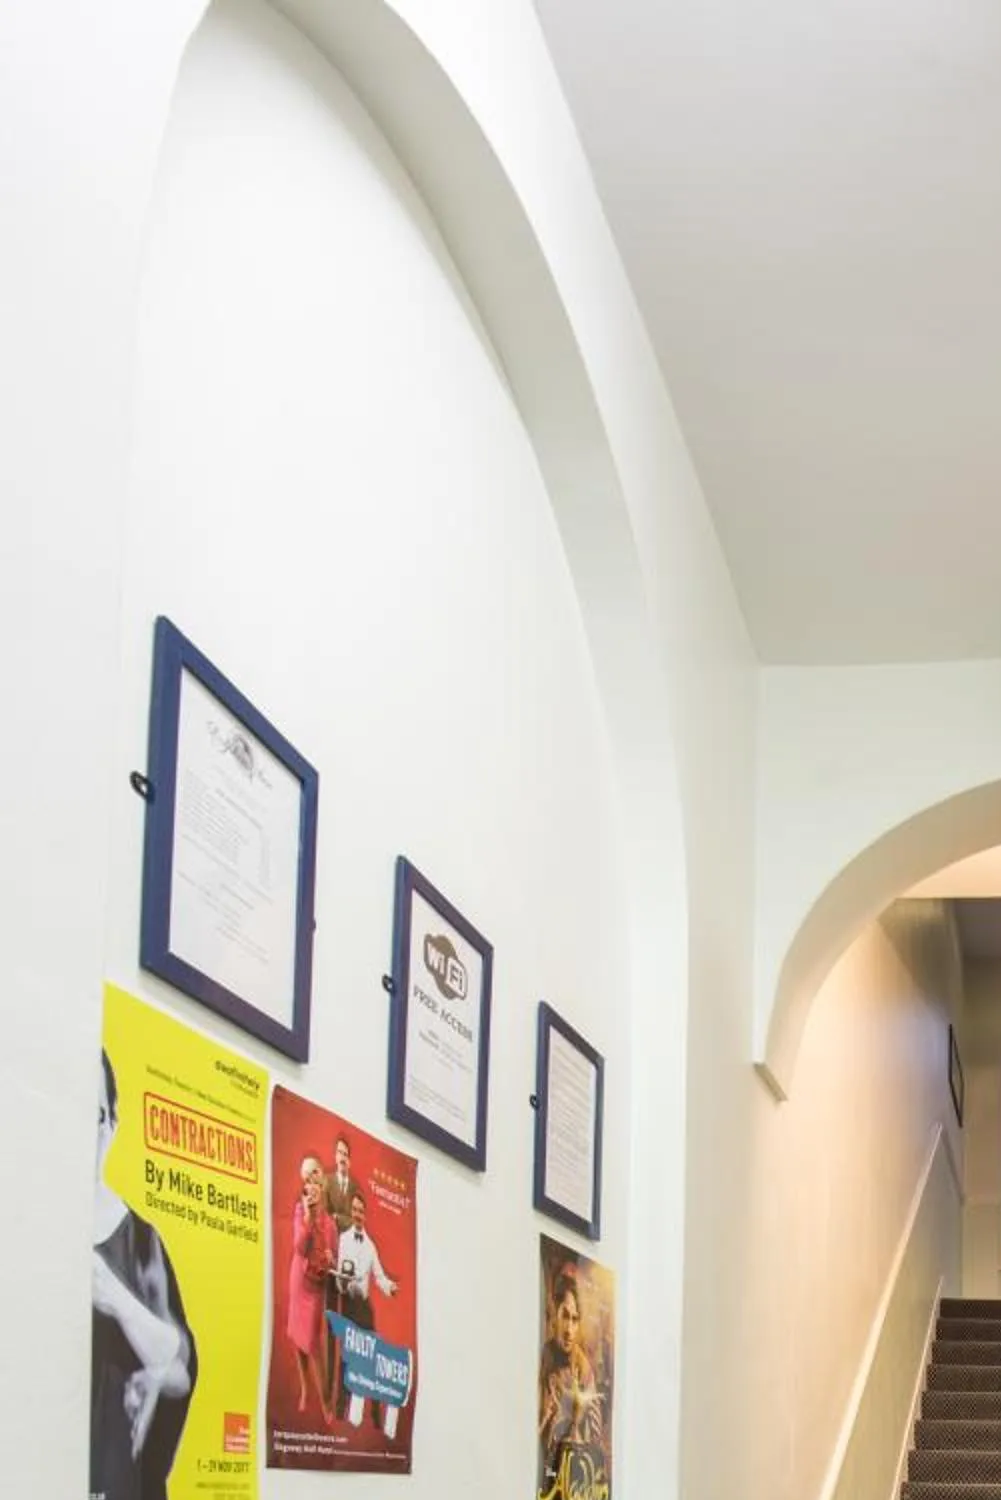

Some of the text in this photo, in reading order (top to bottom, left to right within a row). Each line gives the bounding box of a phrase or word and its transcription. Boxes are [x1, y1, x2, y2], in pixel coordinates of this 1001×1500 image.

[150, 1104, 254, 1173] CONTRACTIONS
[145, 1159, 259, 1221] By Mike Bartlett
[145, 1191, 187, 1220] Directed
[187, 1206, 199, 1226] by
